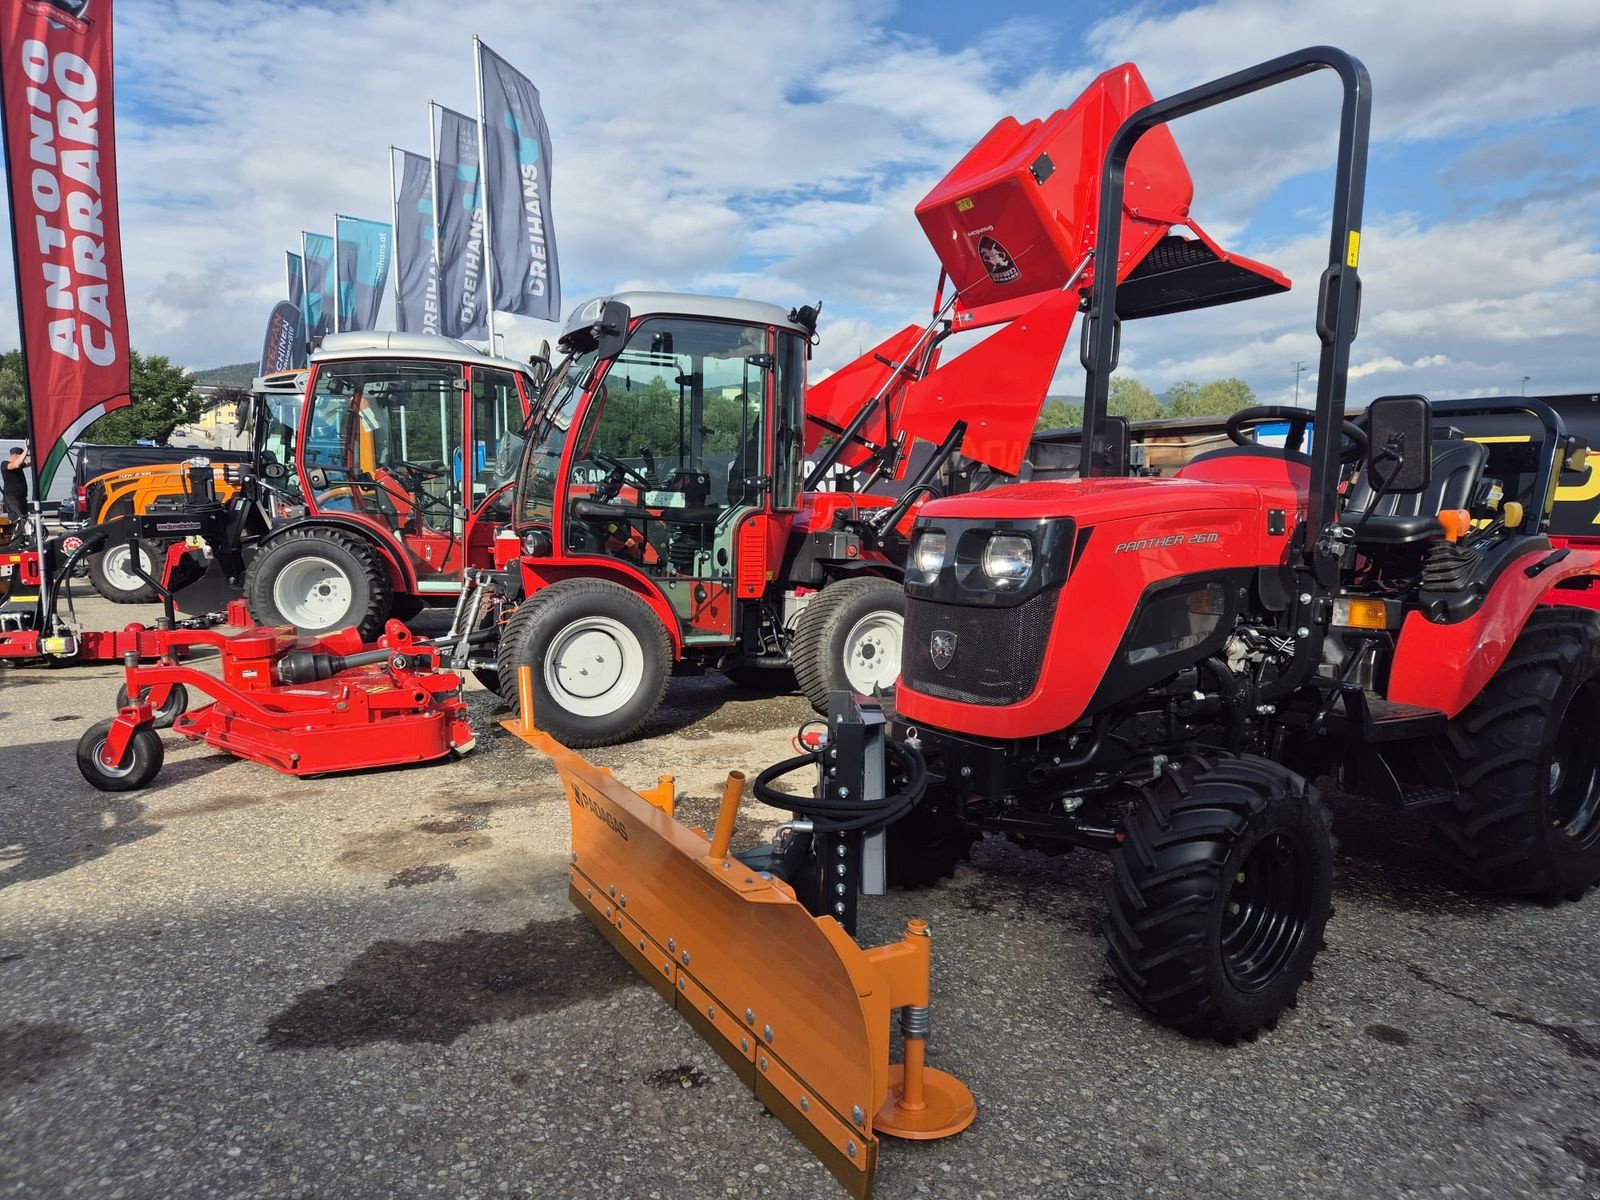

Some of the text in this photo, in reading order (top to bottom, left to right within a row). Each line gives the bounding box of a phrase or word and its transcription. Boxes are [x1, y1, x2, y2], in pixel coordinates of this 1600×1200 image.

[22, 39, 80, 361] ANTONIO
[53, 51, 116, 367] CARRARO
[461, 207, 484, 324] DREIHANS
[521, 163, 548, 297] DREIHANS
[1114, 532, 1218, 555] PANTHER 26M
